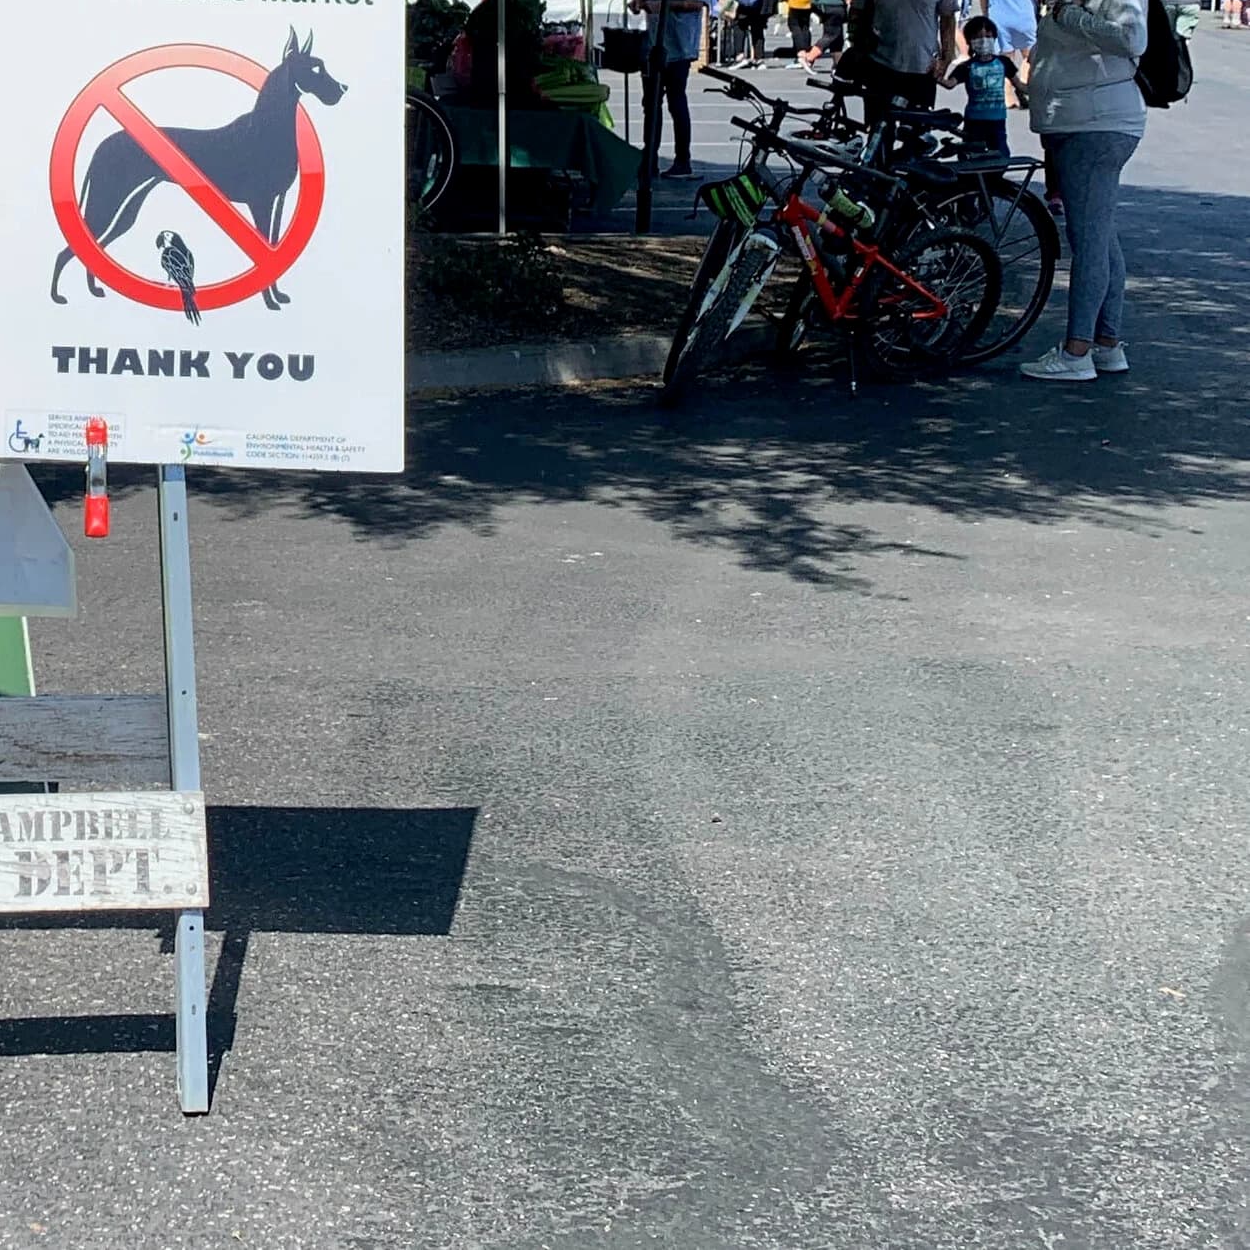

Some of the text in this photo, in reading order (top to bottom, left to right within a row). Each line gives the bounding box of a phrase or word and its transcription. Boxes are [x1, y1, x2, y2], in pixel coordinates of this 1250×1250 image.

[52, 346, 314, 381] THANK YOU
[246, 433, 288, 442] CALIFORNIA
[290, 434, 334, 443] DEPARTMENT
